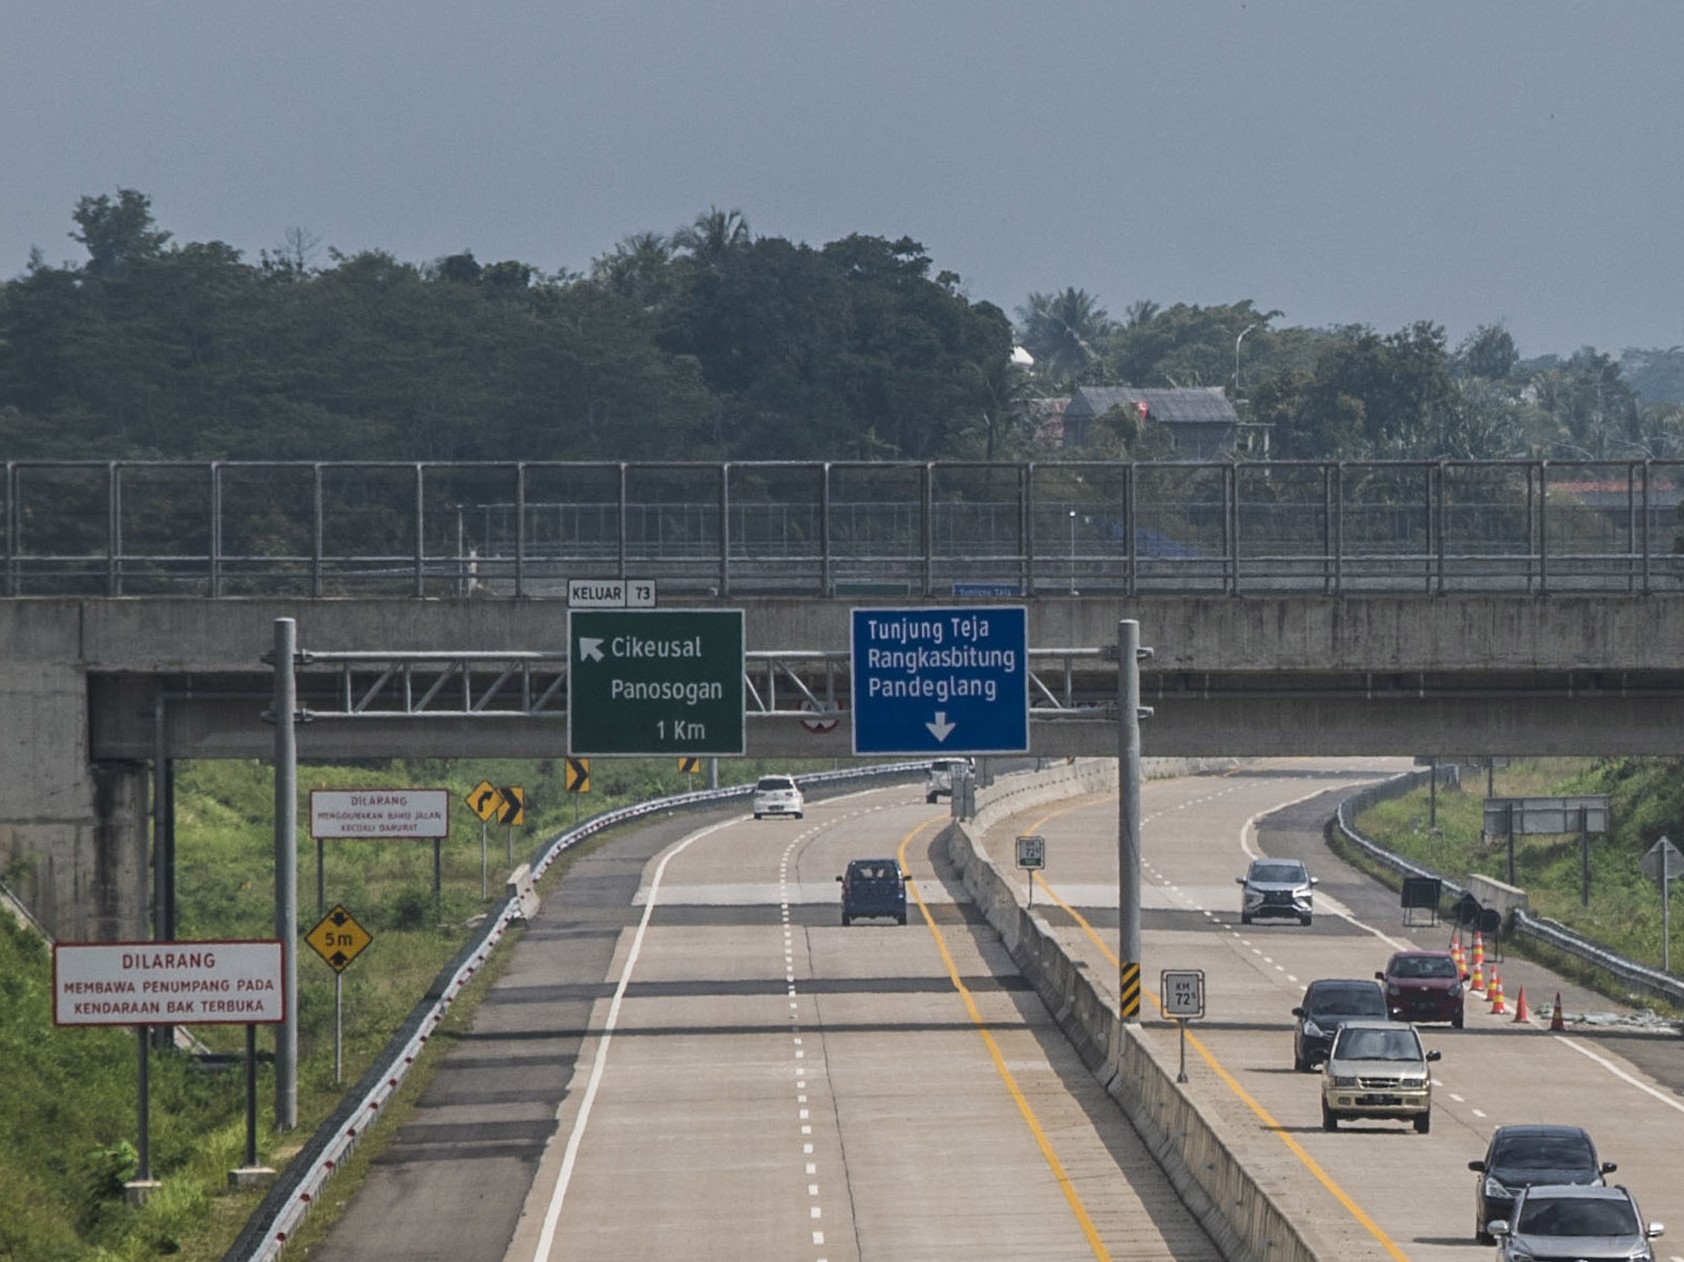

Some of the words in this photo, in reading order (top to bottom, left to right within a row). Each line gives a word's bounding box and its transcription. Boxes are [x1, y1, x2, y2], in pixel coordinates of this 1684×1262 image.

[572, 586, 622, 600] KELUAR
[635, 586, 651, 600] 73
[868, 617, 943, 644] Tunjung
[950, 615, 989, 642] Teja
[611, 636, 702, 657] Cikeusal
[868, 645, 1015, 674] Rangkasbitung
[611, 679, 723, 705] Panosogan
[868, 675, 997, 702] Pandeglang
[656, 720, 665, 740] 1
[674, 720, 706, 740] Km
[350, 796, 408, 807] DILARANG
[121, 952, 216, 969] DILARANG
[64, 981, 136, 994] MEMBAWA
[142, 979, 230, 993] PENUMPANG
[237, 979, 274, 992] PADA
[1175, 982, 1190, 991] KM
[74, 1002, 160, 1015] KENDARAAN
[167, 1001, 194, 1014] BAK
[200, 1000, 264, 1013] TERBUKA
